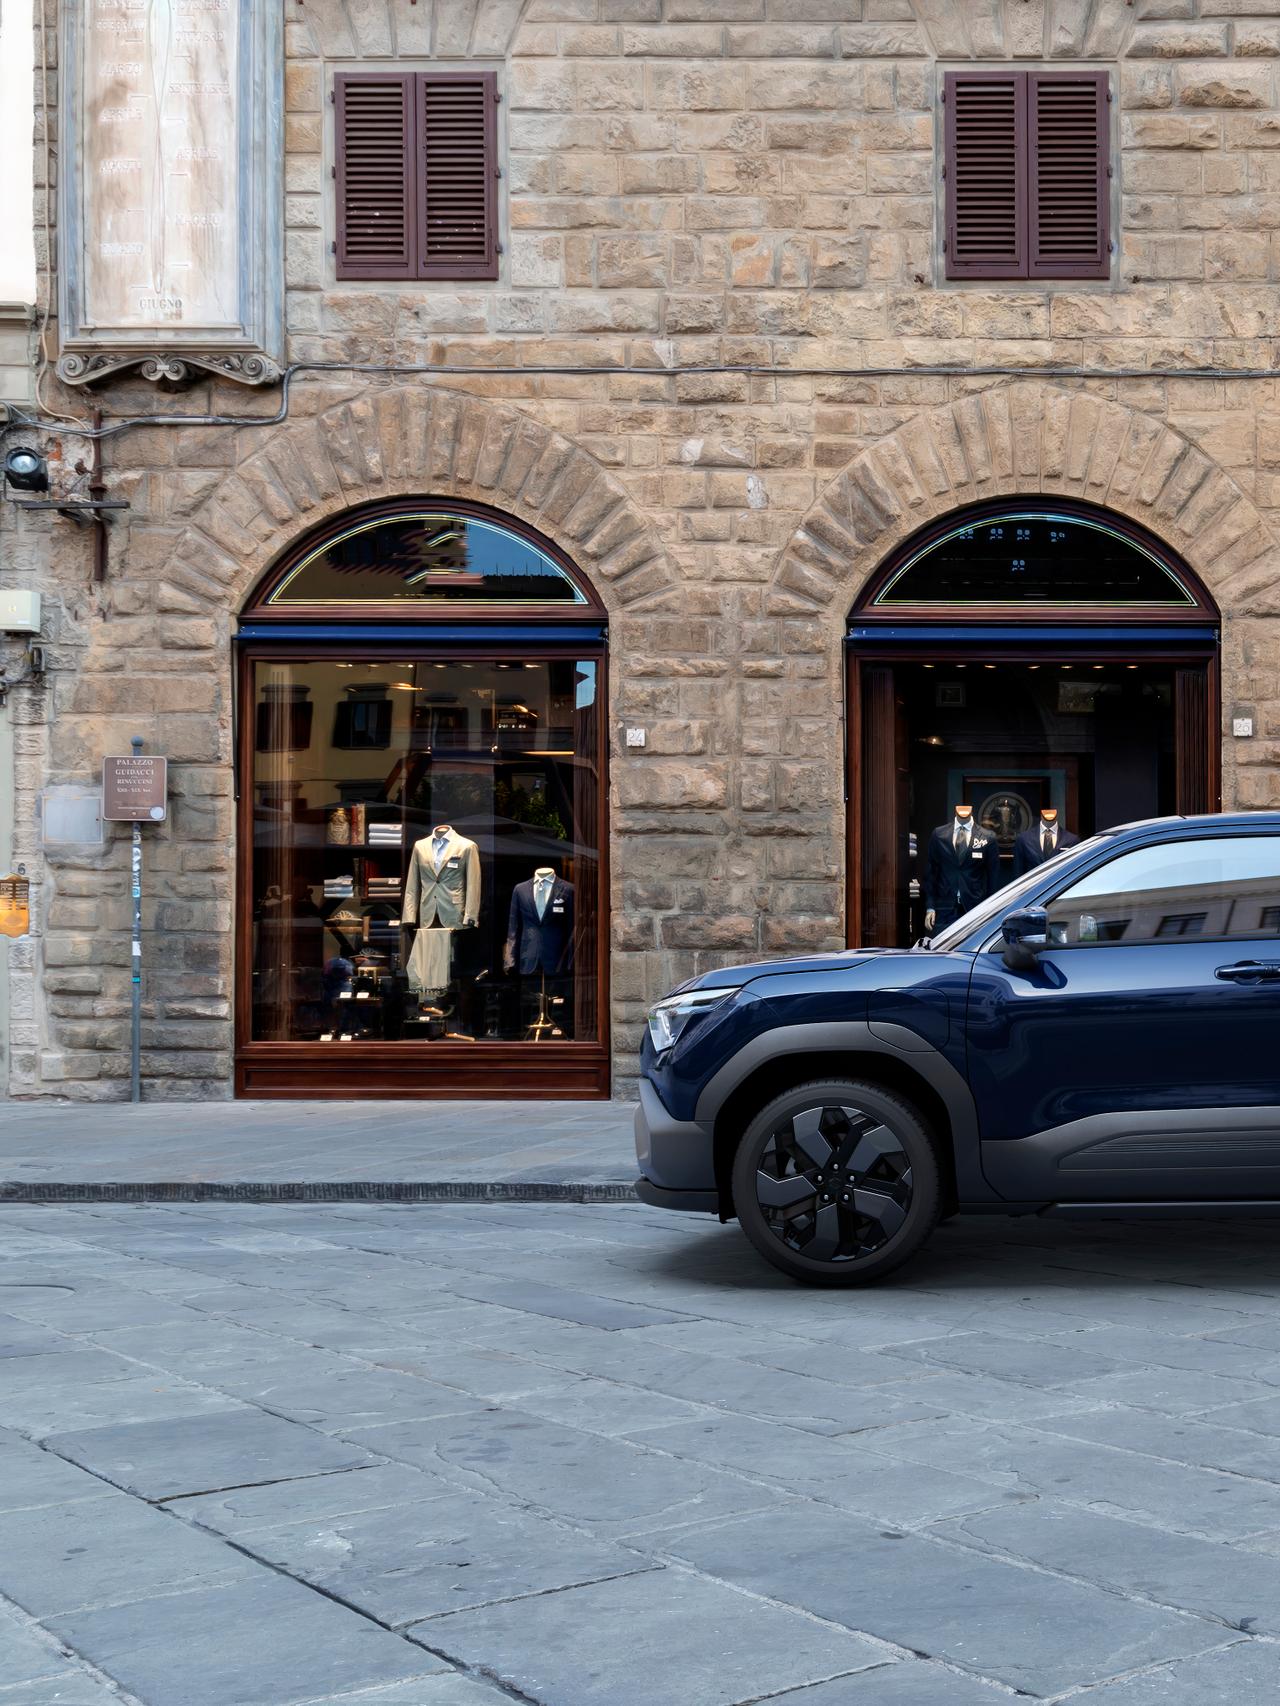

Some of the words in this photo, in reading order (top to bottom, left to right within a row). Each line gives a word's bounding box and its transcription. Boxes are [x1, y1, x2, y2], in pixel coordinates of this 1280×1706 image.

[101, 63, 143, 75] MARZO
[139, 299, 182, 310] GIUGNO
[628, 731, 643, 742] 24
[17, 862, 26, 875] 6
